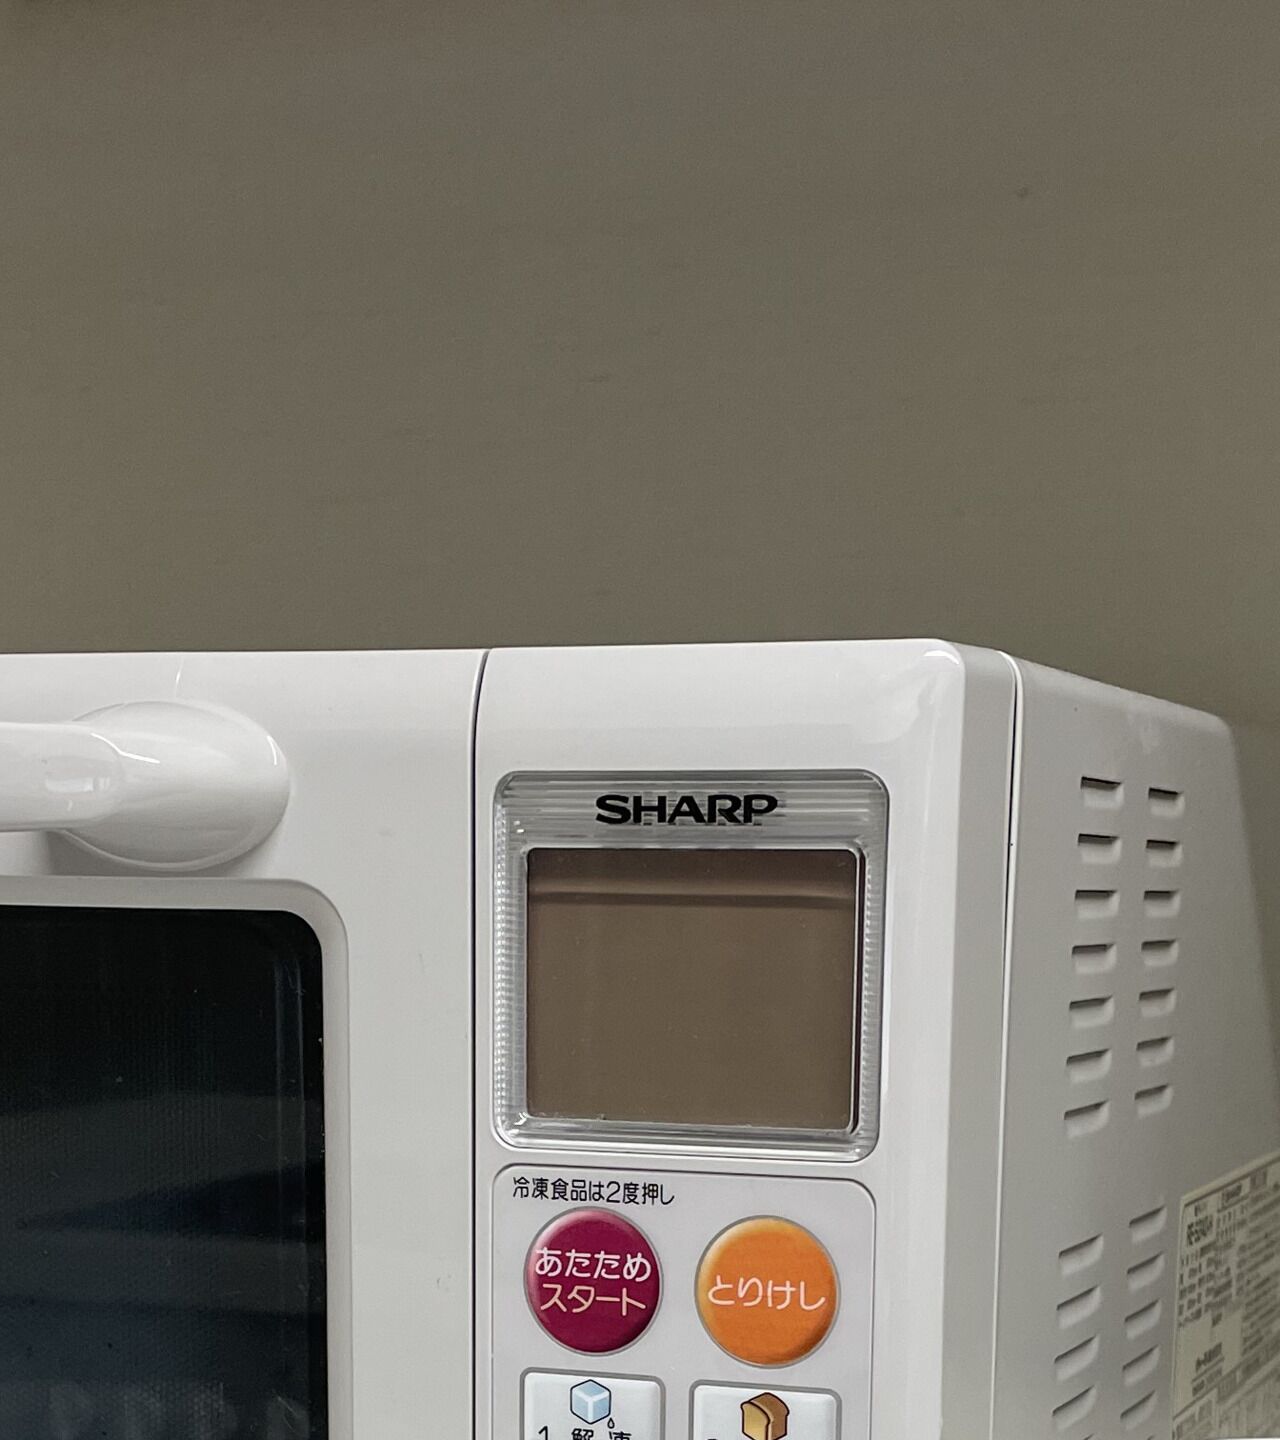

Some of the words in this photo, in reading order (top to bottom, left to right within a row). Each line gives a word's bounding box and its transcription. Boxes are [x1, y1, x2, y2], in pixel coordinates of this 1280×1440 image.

[596, 794, 778, 824] SHARP
[513, 1176, 675, 1206] 冷凍食品は2度押し
[535, 1247, 651, 1281] あたため
[541, 1283, 646, 1316] スタート
[707, 1275, 826, 1311] とりけし
